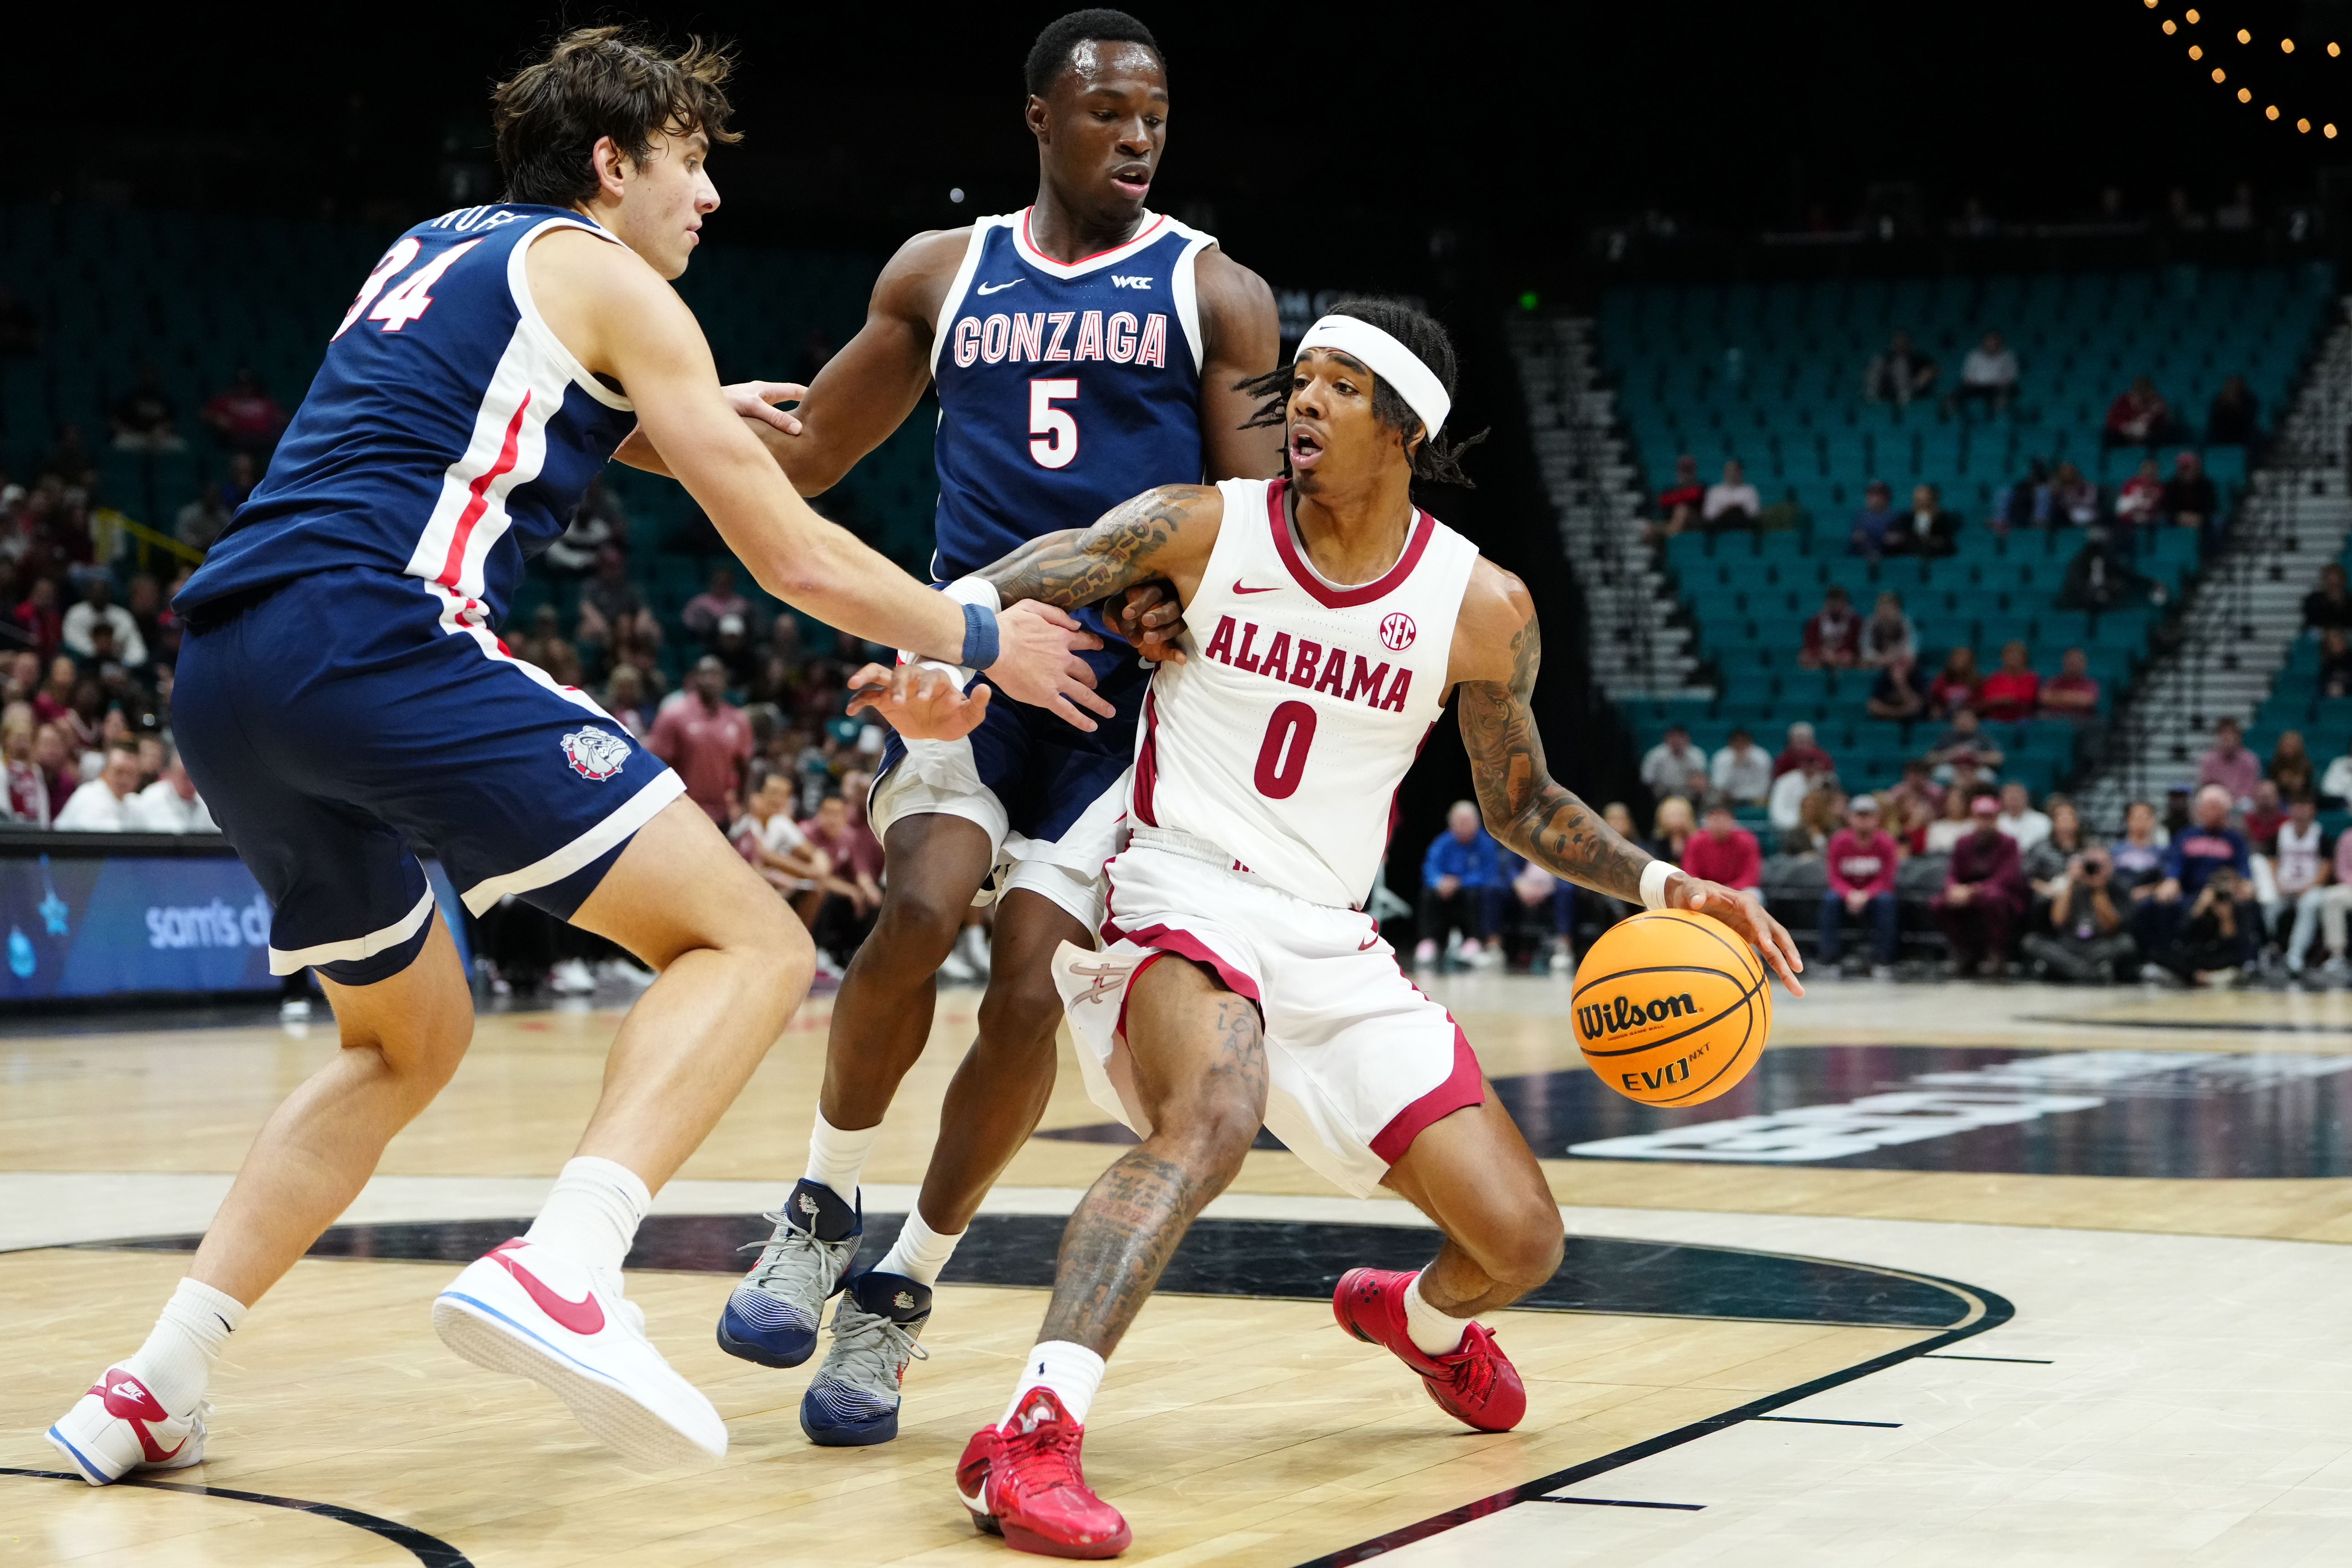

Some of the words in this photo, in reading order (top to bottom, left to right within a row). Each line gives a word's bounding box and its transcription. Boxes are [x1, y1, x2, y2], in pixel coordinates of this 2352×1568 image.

[329, 236, 485, 343] 34
[1111, 275, 1154, 290] WCC
[954, 310, 1167, 368] GONZAGA
[1029, 378, 1079, 469] 5
[1381, 613, 1415, 650] SEC
[1205, 614, 1413, 713] ALABAMA
[1253, 700, 1317, 799] 0
[1577, 992, 1698, 1040] Wilson
[1629, 1028, 1647, 1037] GAME
[1688, 1041, 1711, 1062] NXT
[119, 1380, 146, 1398] NIKE
